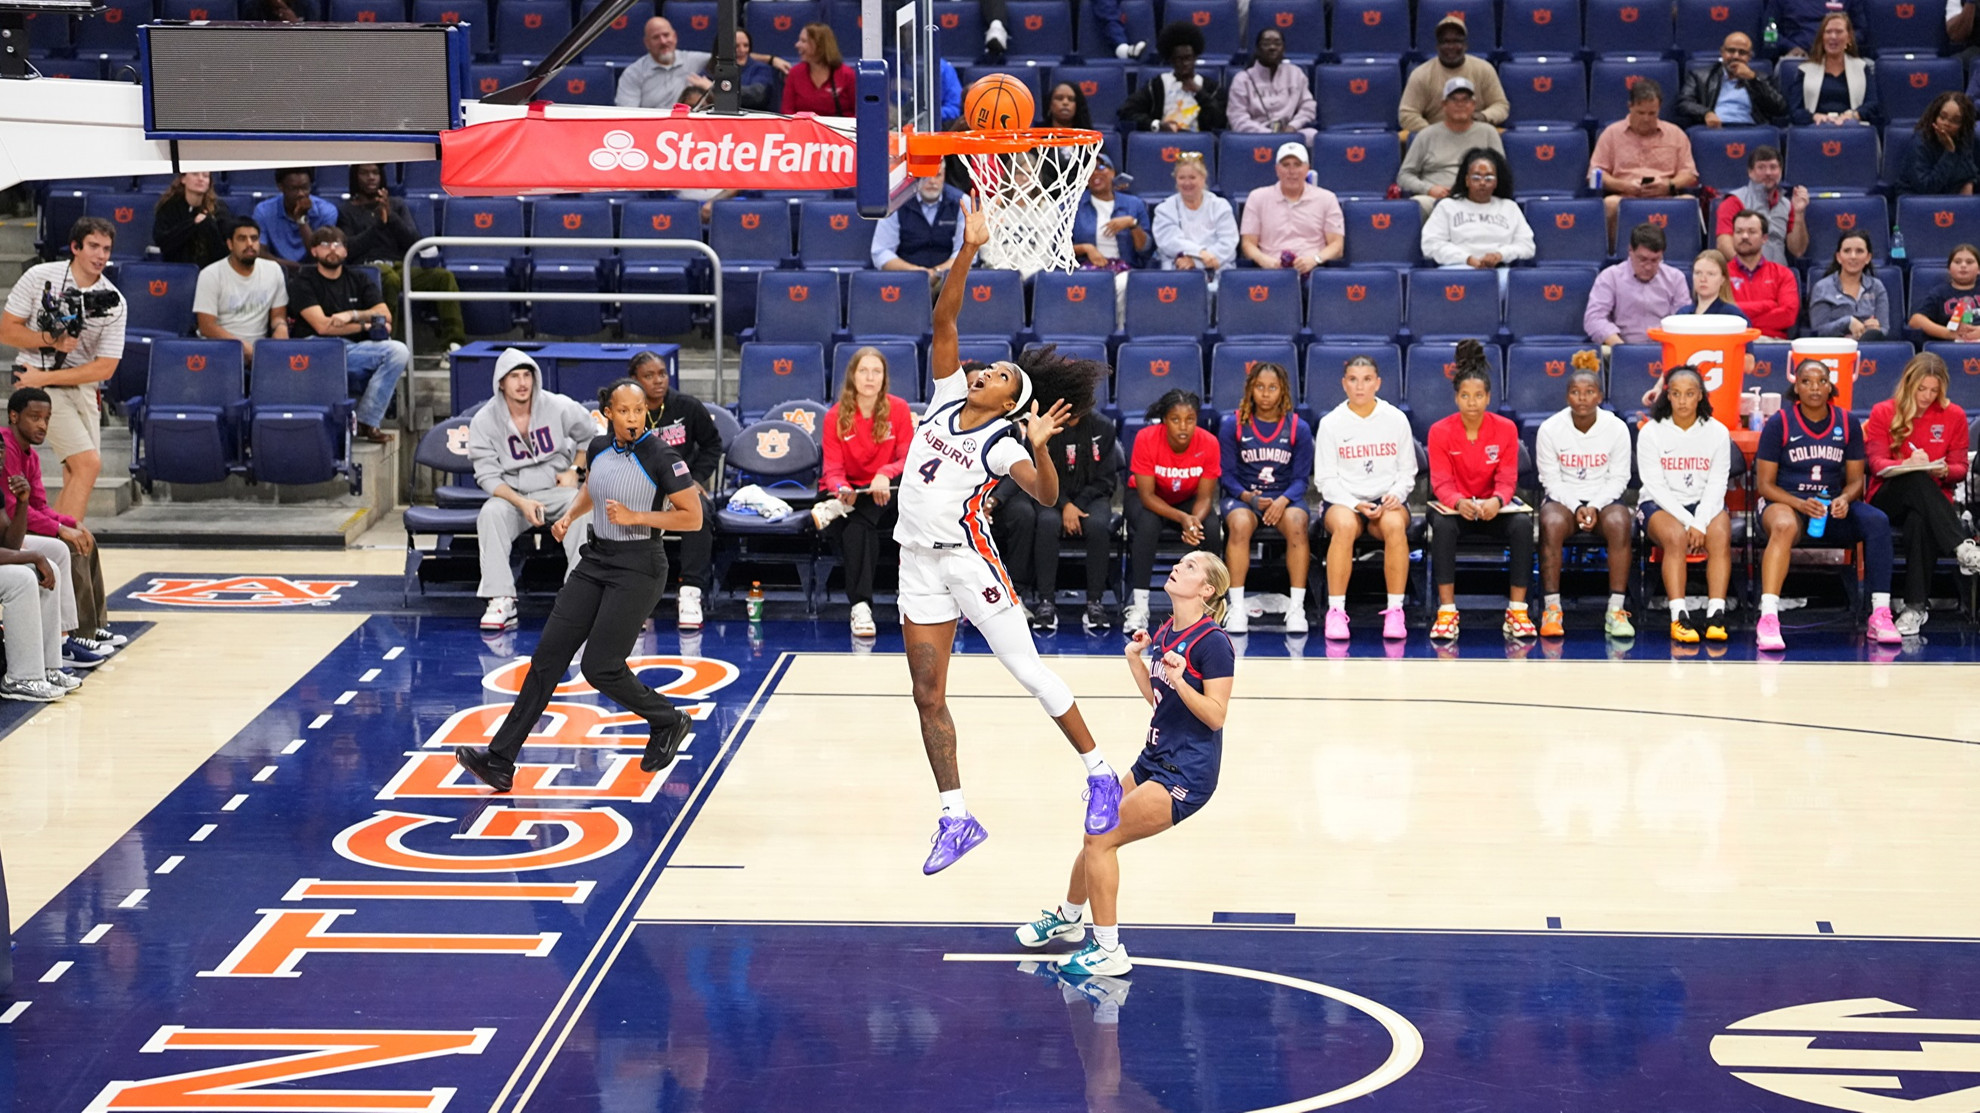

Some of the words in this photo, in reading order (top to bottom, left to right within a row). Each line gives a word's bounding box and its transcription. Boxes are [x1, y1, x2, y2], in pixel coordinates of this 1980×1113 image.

[652, 131, 758, 171] State
[759, 133, 853, 173] Farm
[923, 429, 974, 470] AUBURN
[1240, 447, 1292, 465] COLUMBUS
[1338, 443, 1398, 460] RELENTLESS
[1788, 445, 1845, 463] COLUMBUS
[918, 457, 943, 485] 4
[1190, 466, 1204, 477] UP
[1257, 466, 1276, 484] 4
[1810, 465, 1823, 481] 1
[195, 654, 741, 978] TIGERS
